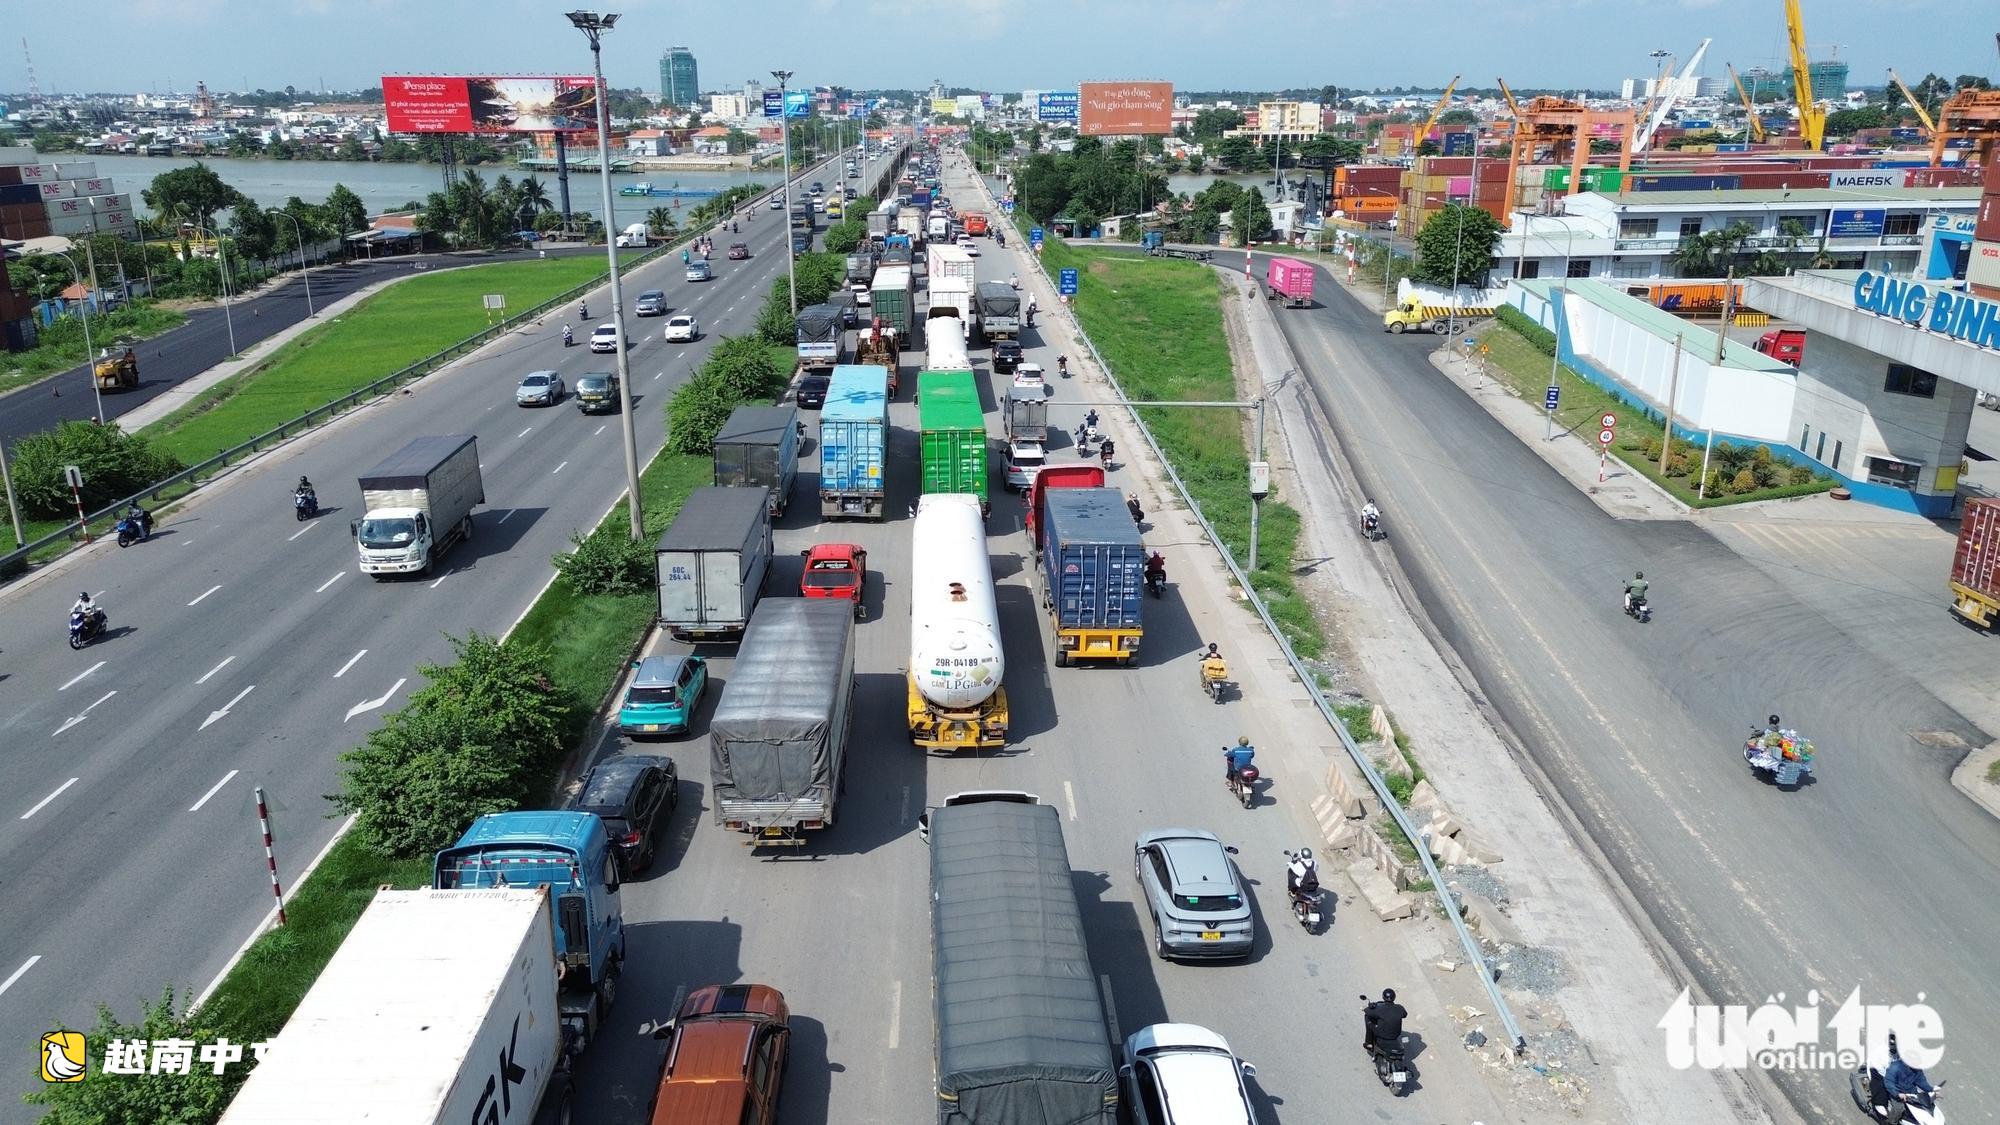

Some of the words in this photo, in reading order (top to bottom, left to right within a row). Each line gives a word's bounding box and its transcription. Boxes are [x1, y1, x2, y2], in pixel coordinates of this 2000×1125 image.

[24, 167, 42, 177] ONE
[87, 180, 102, 190] ONE
[1836, 176, 1894, 186] MAERSK
[43, 184, 60, 194] ONE
[61, 201, 78, 211] ONE
[105, 197, 120, 207] ONE
[109, 213, 123, 223] ONE
[1854, 262, 1928, 324] CẢNG
[672, 566, 685, 574] 60C
[935, 658, 978, 667] 29R-04189
[946, 680, 970, 690] LPG
